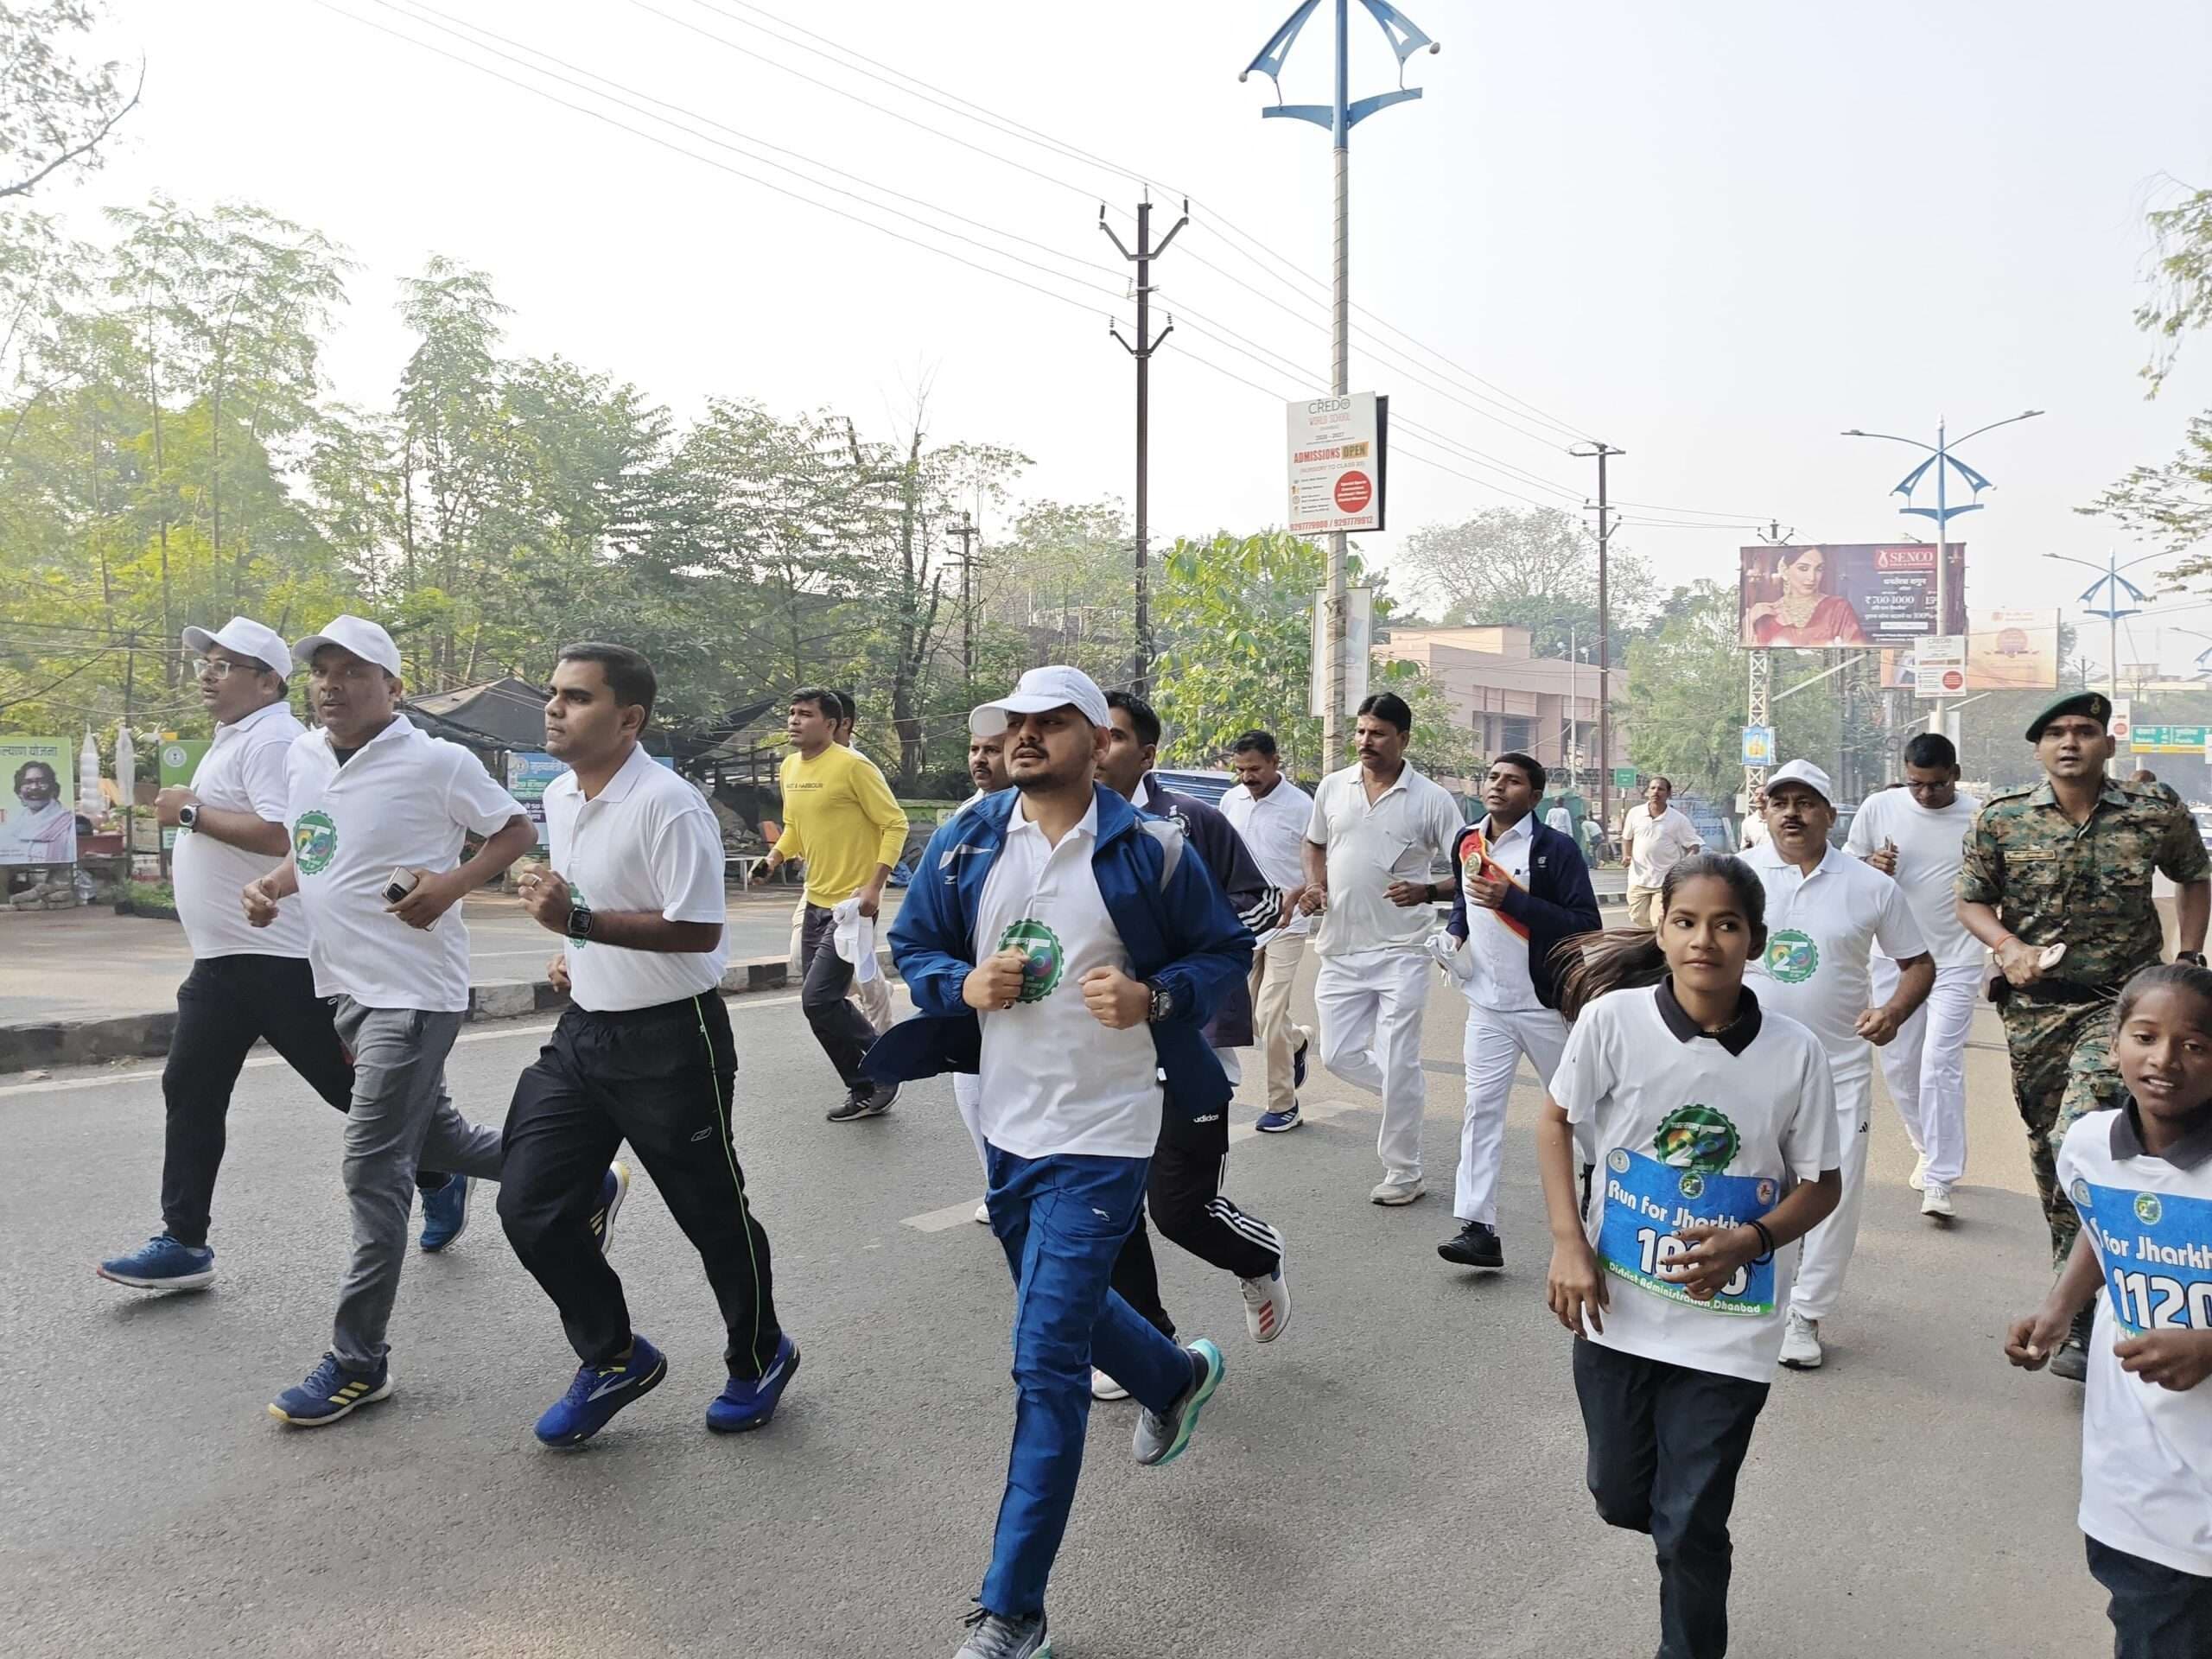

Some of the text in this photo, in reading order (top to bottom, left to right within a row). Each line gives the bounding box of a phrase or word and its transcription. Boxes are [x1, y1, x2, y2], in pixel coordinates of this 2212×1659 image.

[1308, 398, 1351, 415] CREDO
[1294, 443, 1366, 464] ADMISSIONS OPEN
[1890, 551, 1933, 563] SENCO
[1193, 1114, 1219, 1123] adidas
[1608, 1179, 1637, 1210] Run
[1641, 1195, 1669, 1223] for
[2102, 1230, 2130, 1257] for
[1609, 1262, 1638, 1284] District
[1714, 1299, 1761, 1313] Dhanbad
